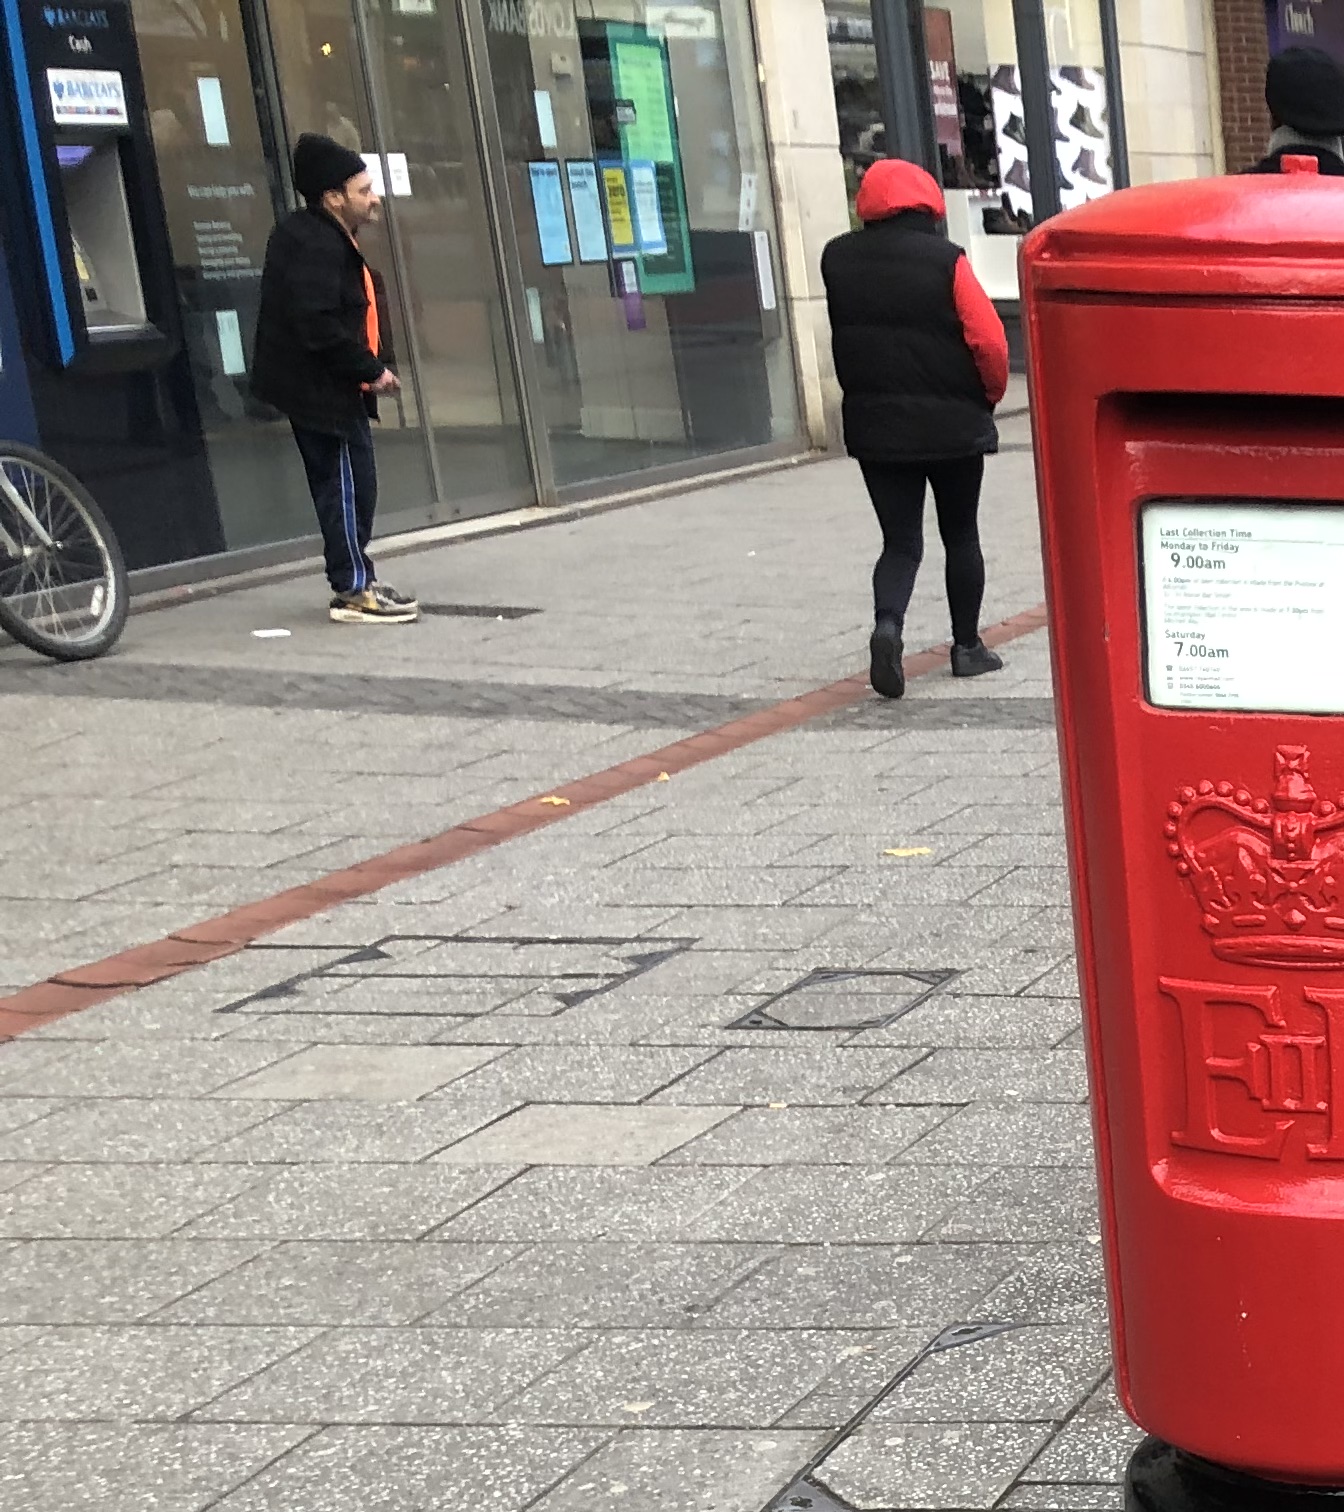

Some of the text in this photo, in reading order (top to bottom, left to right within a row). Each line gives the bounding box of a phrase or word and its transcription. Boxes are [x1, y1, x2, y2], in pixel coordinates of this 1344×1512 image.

[1160, 527, 1252, 538] Last Collection Time
[1160, 541, 1239, 554] Monday to Friday
[1170, 552, 1226, 569] 9.00am
[1165, 629, 1205, 640] Saturday
[1173, 642, 1229, 658] 7.00am
